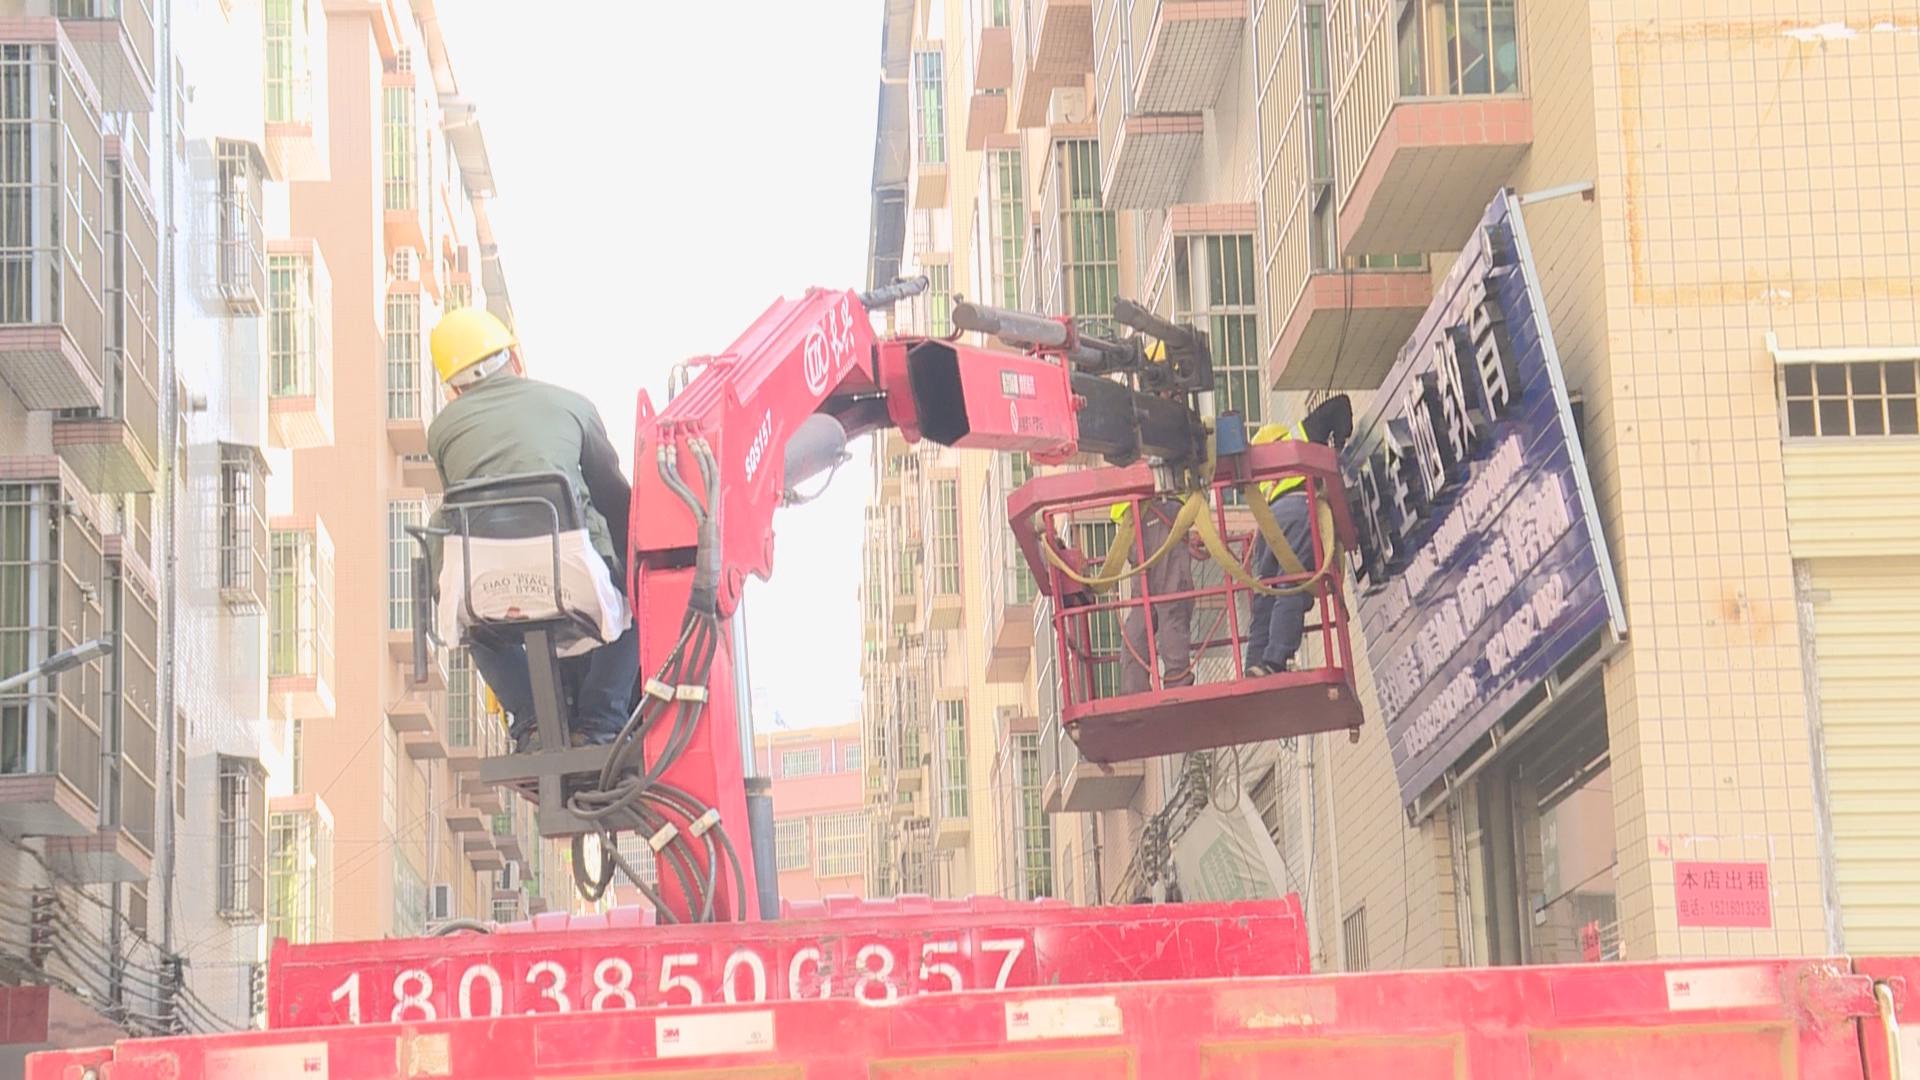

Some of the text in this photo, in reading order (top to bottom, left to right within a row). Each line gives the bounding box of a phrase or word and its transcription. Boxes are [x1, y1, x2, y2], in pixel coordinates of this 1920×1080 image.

[1681, 868, 1766, 890] 本店出租
[331, 938, 1025, 1025] 18038500857
[1014, 1013, 1029, 1021] 3M
[663, 1028, 680, 1038] 3M
